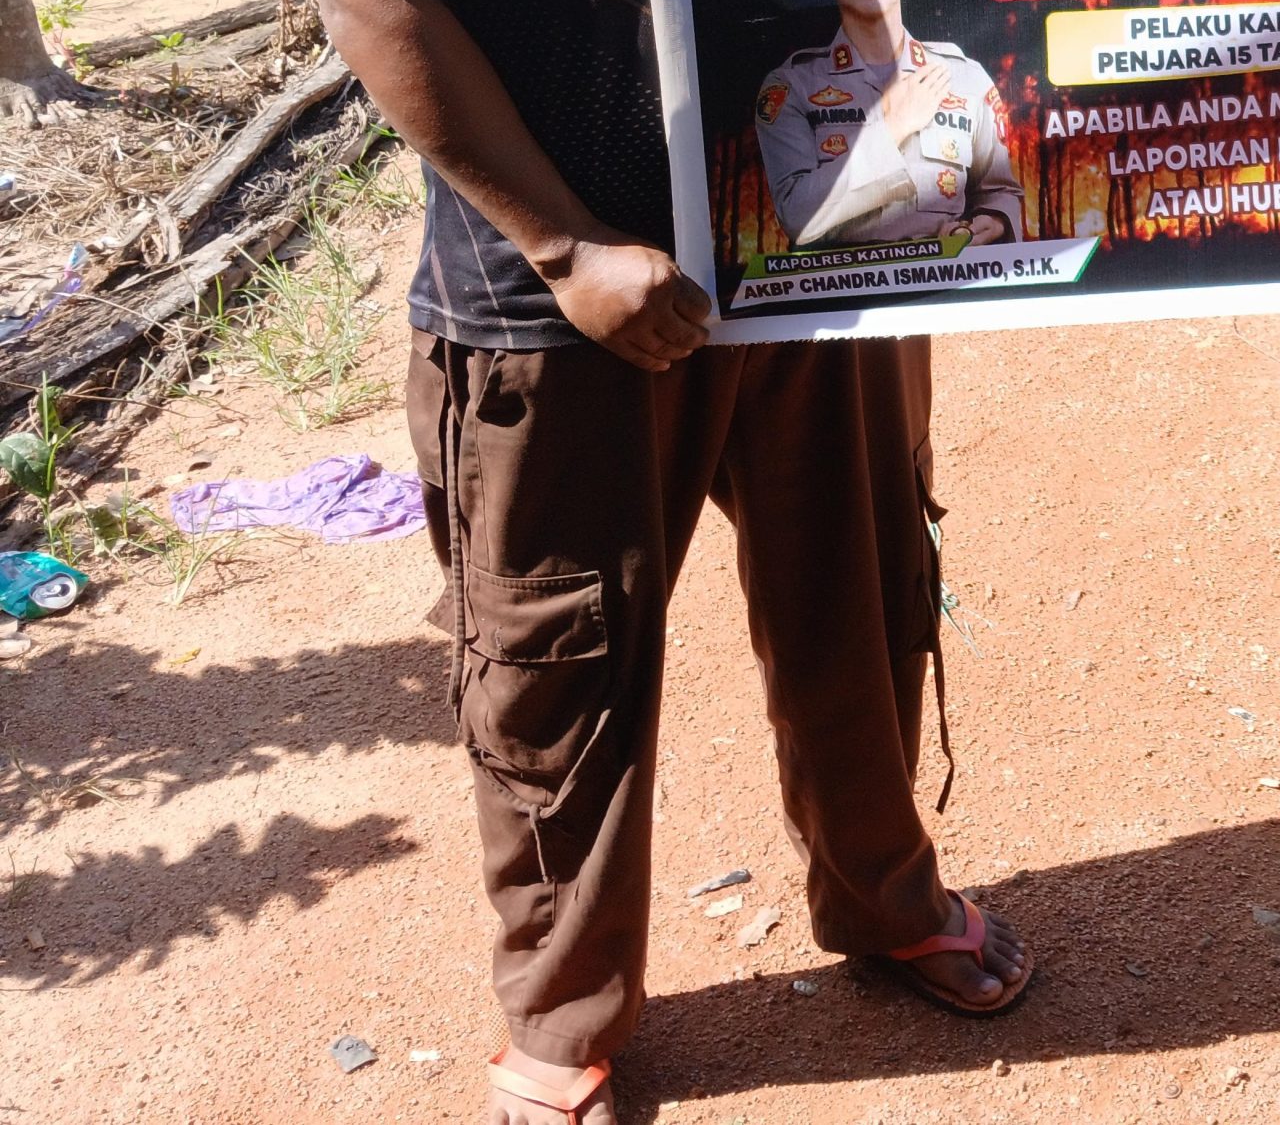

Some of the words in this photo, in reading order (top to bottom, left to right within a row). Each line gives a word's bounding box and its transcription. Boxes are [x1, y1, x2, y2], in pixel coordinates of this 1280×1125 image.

[1130, 13, 1231, 40] PELAKU
[1098, 46, 1223, 74] PENJARA
[1227, 45, 1251, 66] 15
[934, 111, 972, 133] OLRI
[1045, 103, 1173, 139] APABILA
[1177, 96, 1263, 125] ANDA
[1108, 137, 1271, 176] LAPORKAN
[1148, 186, 1224, 218] ATAU
[767, 252, 853, 272] KAPOLRES
[856, 242, 940, 263] KATINGAN
[743, 280, 795, 300] AKBP
[799, 269, 889, 294] CHANDRA
[894, 261, 1009, 287] ISMAWANTO,
[1013, 257, 1060, 277] S.I.K.
